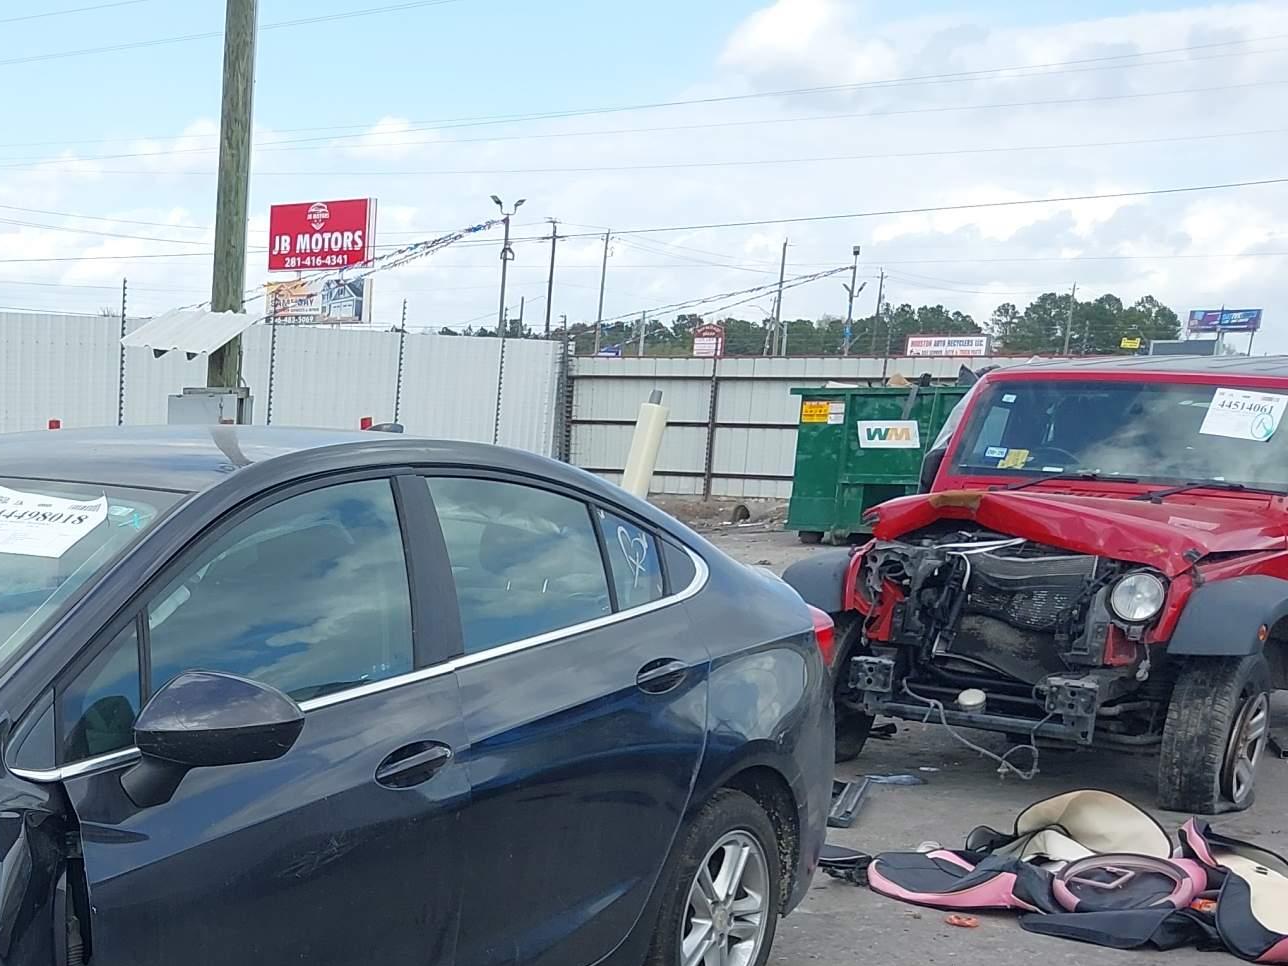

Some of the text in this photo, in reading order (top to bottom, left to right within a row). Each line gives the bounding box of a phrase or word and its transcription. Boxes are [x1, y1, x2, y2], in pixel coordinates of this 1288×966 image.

[272, 230, 363, 255] JB MOTORS
[284, 254, 348, 268] 281-416-4341
[1218, 400, 1274, 414] 44514061
[866, 427, 911, 441] WM
